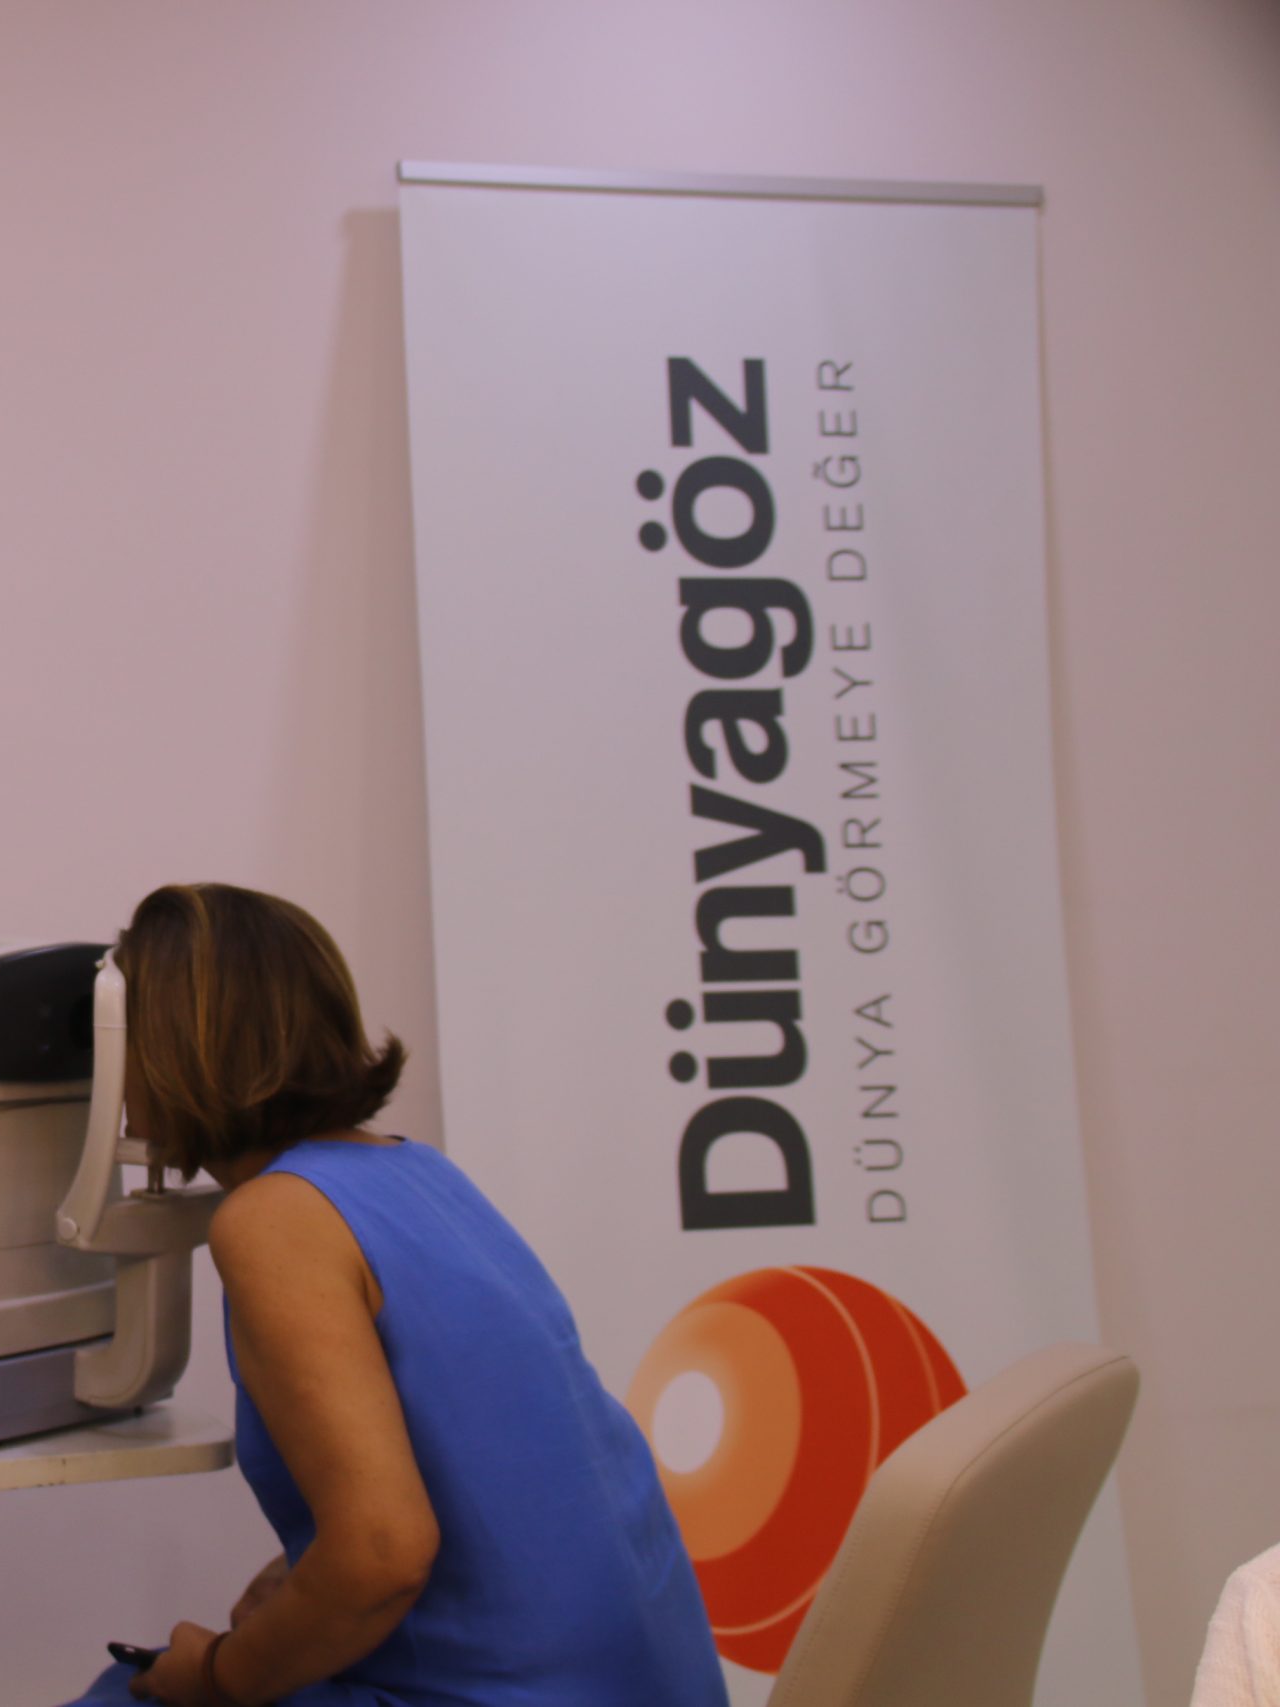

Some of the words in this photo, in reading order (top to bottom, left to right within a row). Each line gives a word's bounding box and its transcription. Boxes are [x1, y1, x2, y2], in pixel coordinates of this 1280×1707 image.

[812, 359, 868, 582] DEĞER
[634, 356, 828, 1233] Dünyagöz
[831, 622, 890, 955] GÖRMEYE
[852, 993, 908, 1226] DÜNYA
